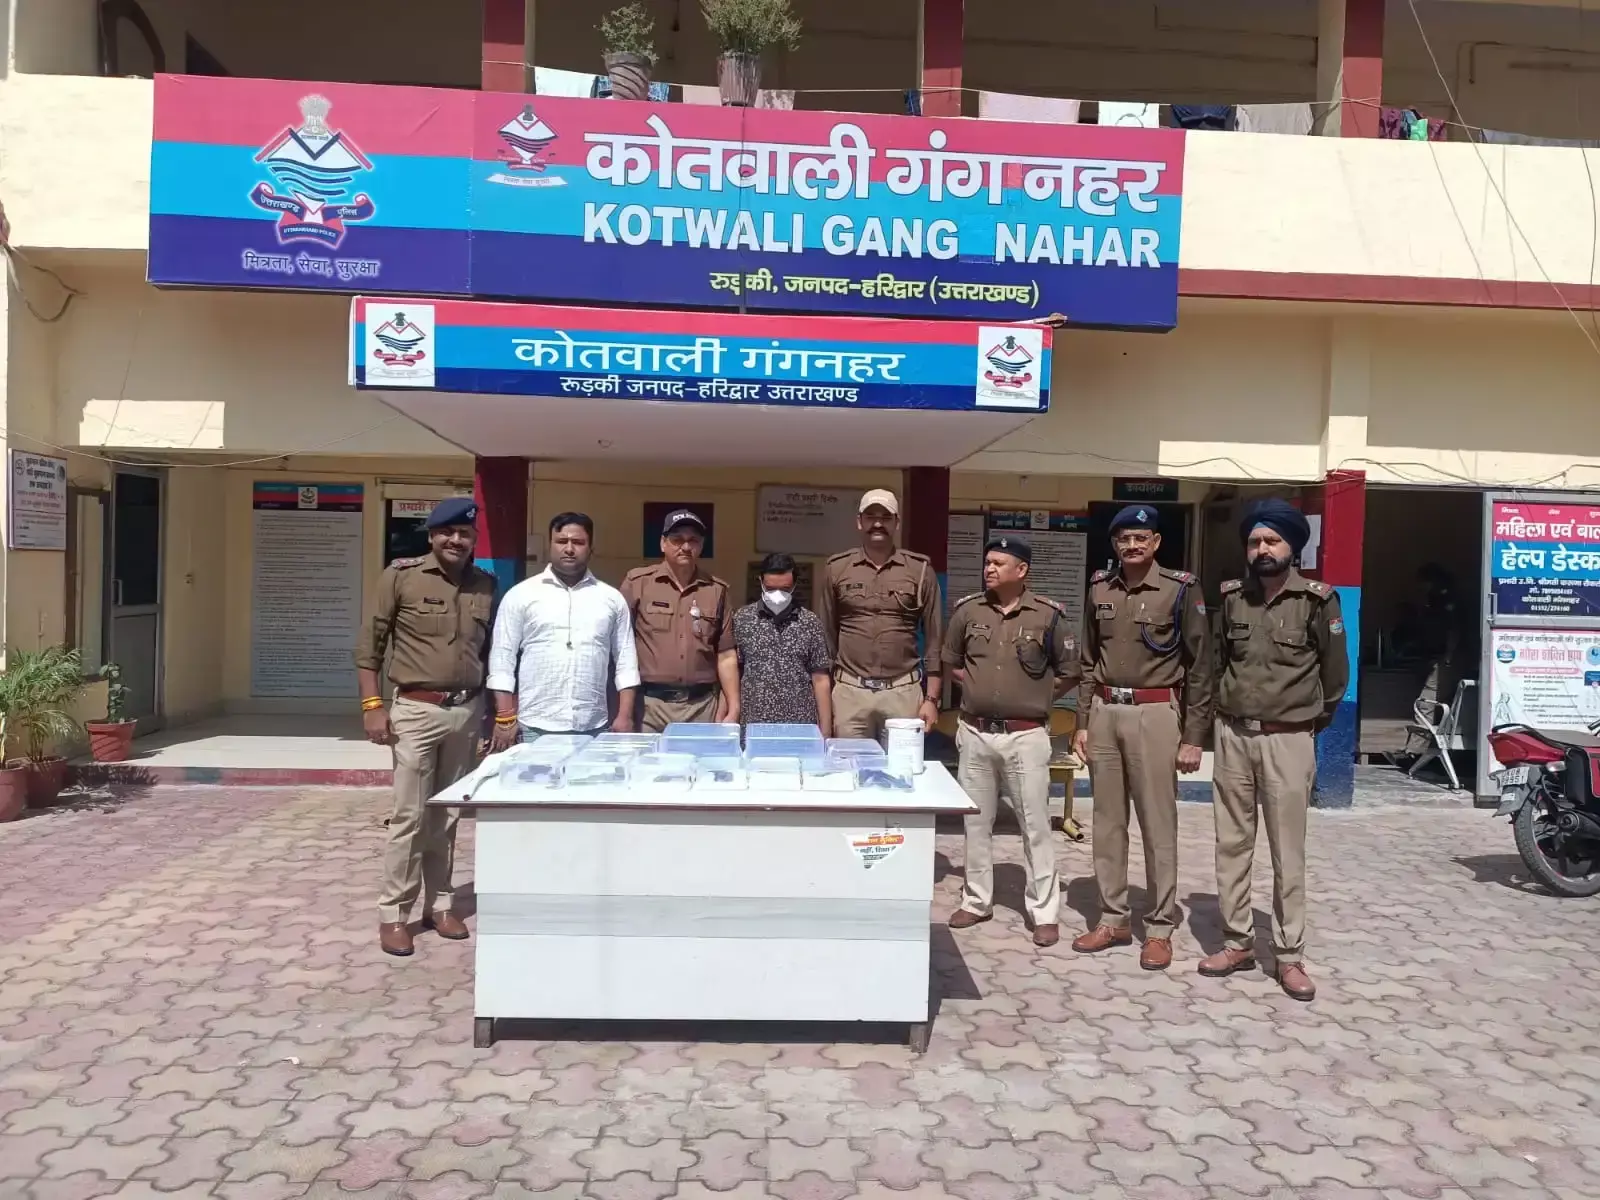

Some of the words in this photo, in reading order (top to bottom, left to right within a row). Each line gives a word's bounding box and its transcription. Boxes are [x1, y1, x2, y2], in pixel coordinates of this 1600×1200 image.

[584, 113, 876, 200] कोतवाली
[259, 193, 301, 214] उत्तराखण्ड
[336, 207, 359, 219] पुलिस
[584, 202, 804, 253] KOTWALI
[822, 214, 959, 260] GANG
[995, 222, 1160, 268] NAHAR
[243, 251, 294, 273] मित्रता,
[298, 254, 333, 276] सेवा,
[337, 258, 379, 279] सुरक्षा
[783, 273, 927, 300] जनपद-हरिद्वार
[929, 275, 1040, 310] (उत्तराखण्ड)
[512, 330, 728, 374] कोतवाली
[740, 340, 906, 383] गंगनहर
[560, 374, 622, 397] रूड़की
[626, 378, 762, 400] जनपद-हरिद्वार
[767, 384, 860, 402] उत्तराखण्ड
[1496, 516, 1546, 538] महिला
[1550, 519, 1576, 538] एवं
[1501, 542, 1547, 571] हेल्प
[1551, 543, 1600, 572] डेस्क
